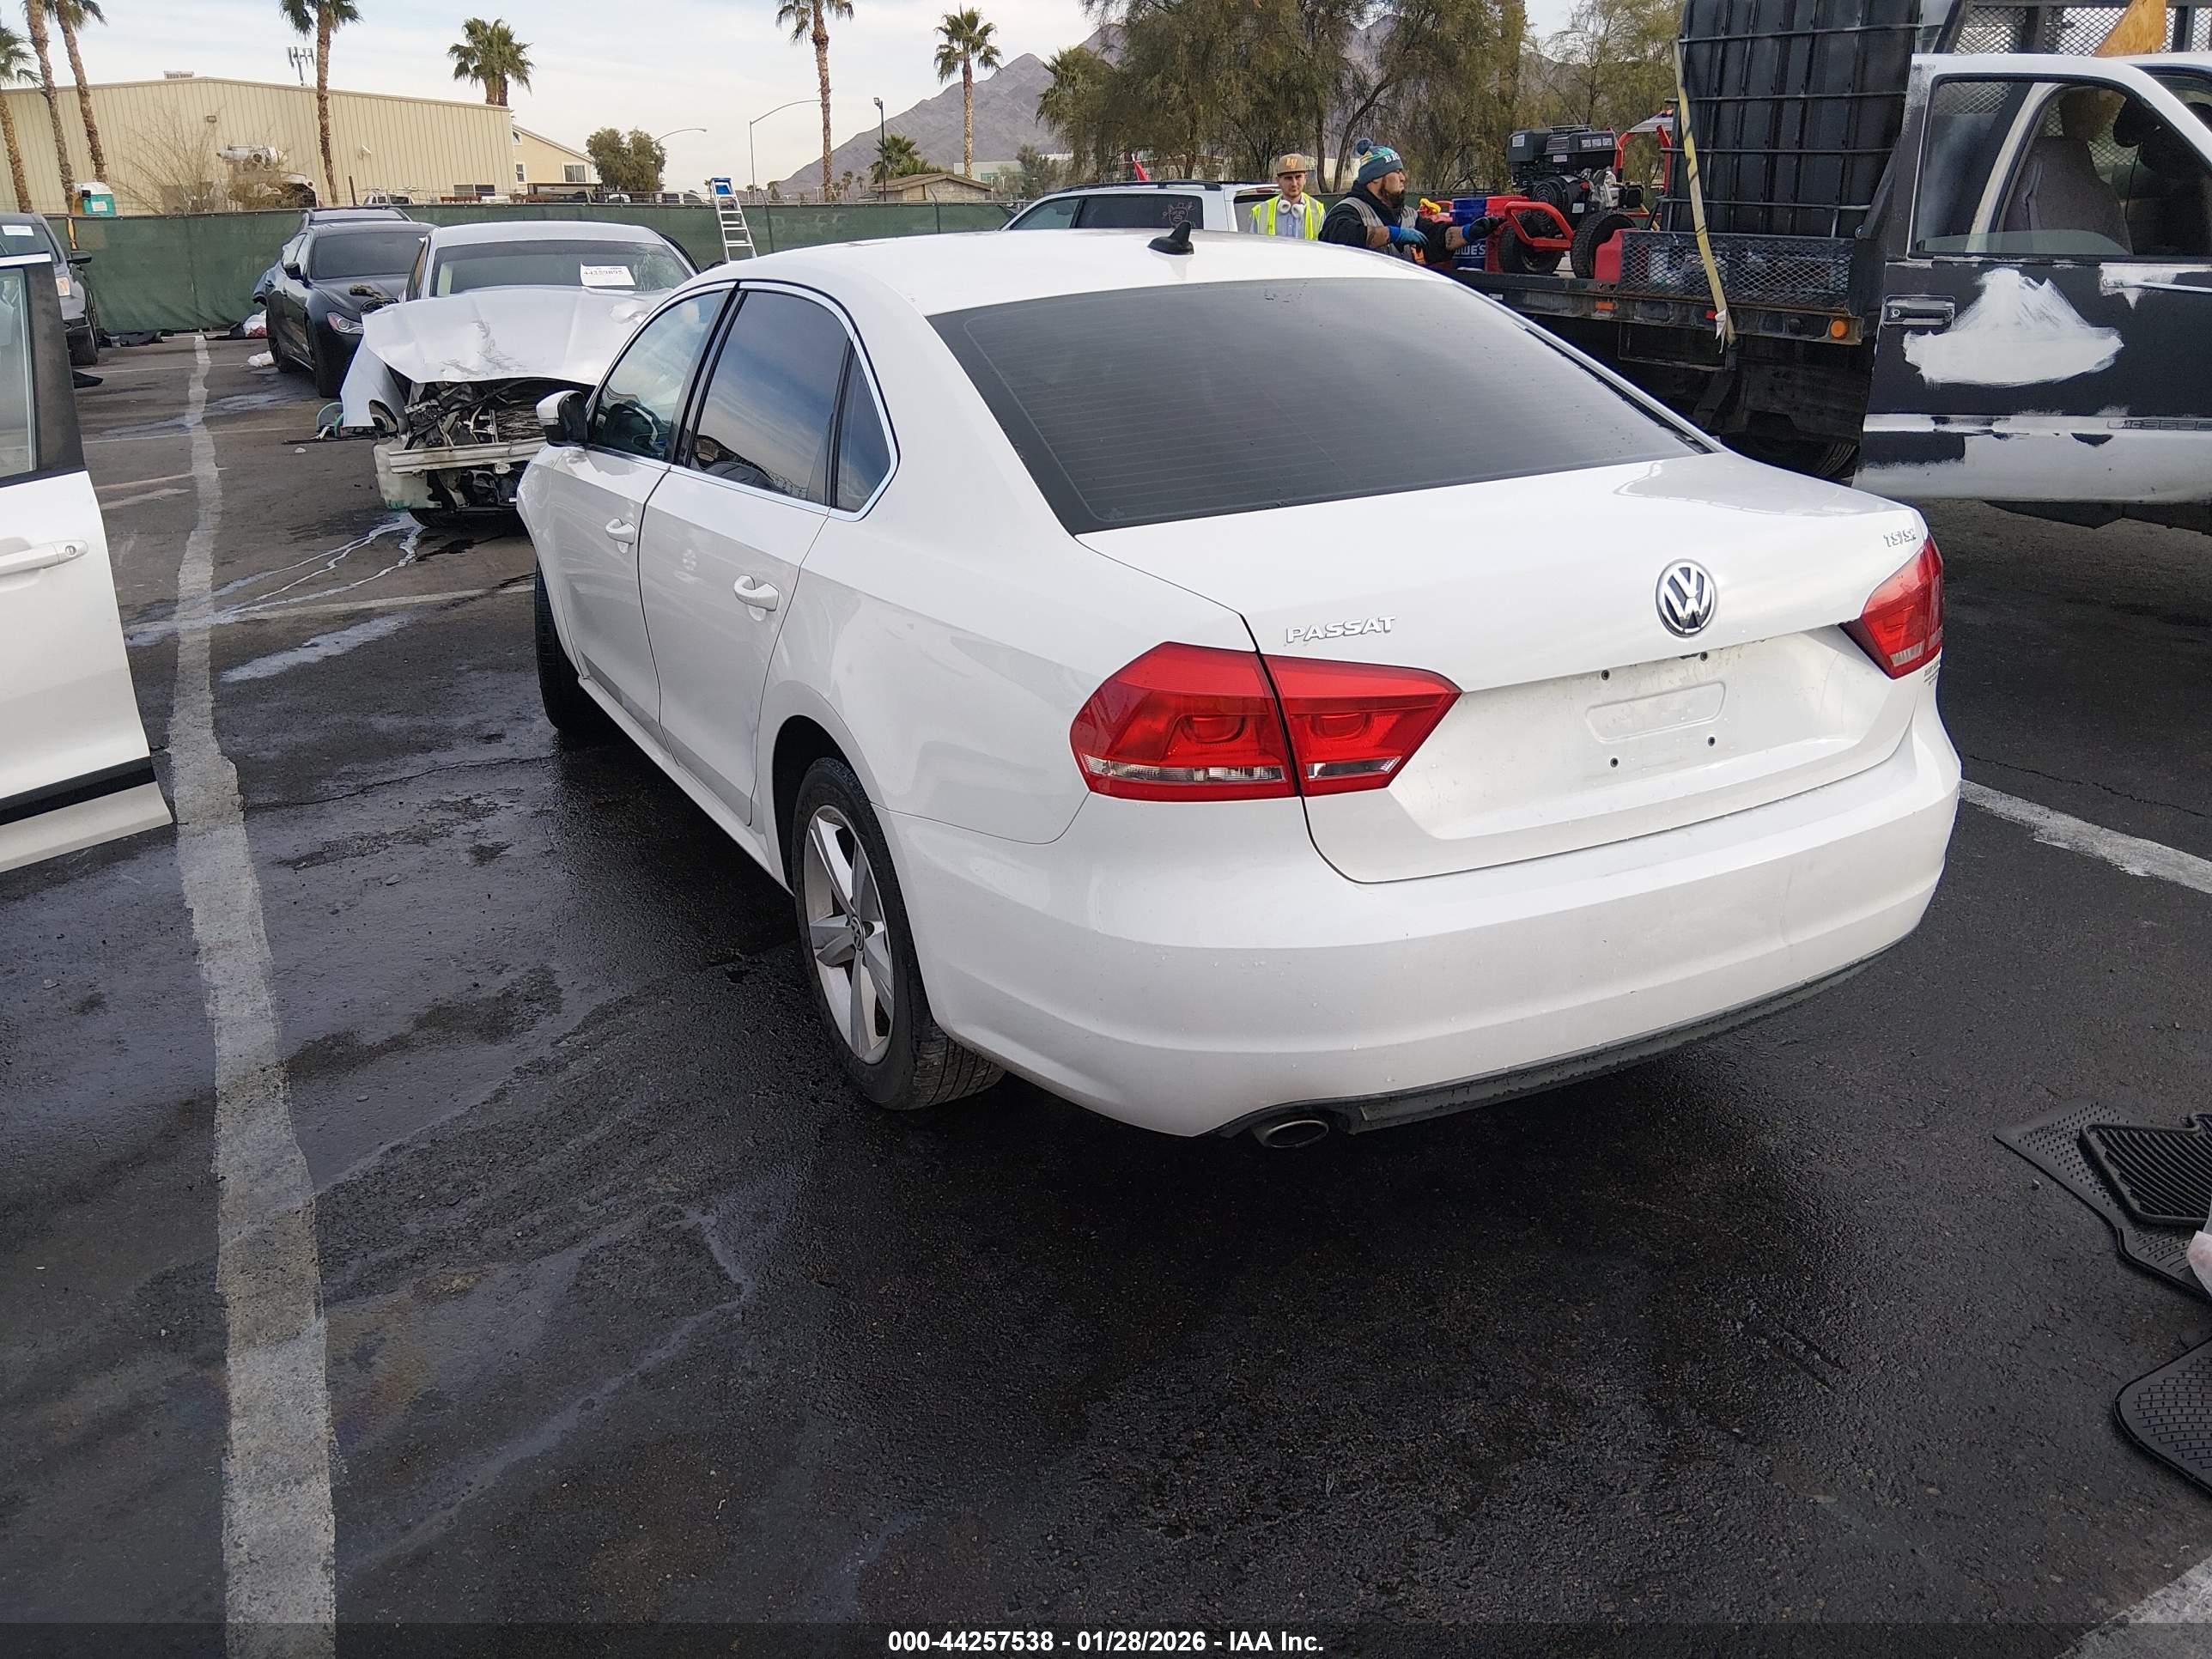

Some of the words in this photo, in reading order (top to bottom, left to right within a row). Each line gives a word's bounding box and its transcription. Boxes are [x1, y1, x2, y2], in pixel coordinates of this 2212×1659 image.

[1455, 245, 1486, 255] WE'S
[1659, 561, 1715, 633] VW
[1286, 616, 1395, 643] PASSAT
